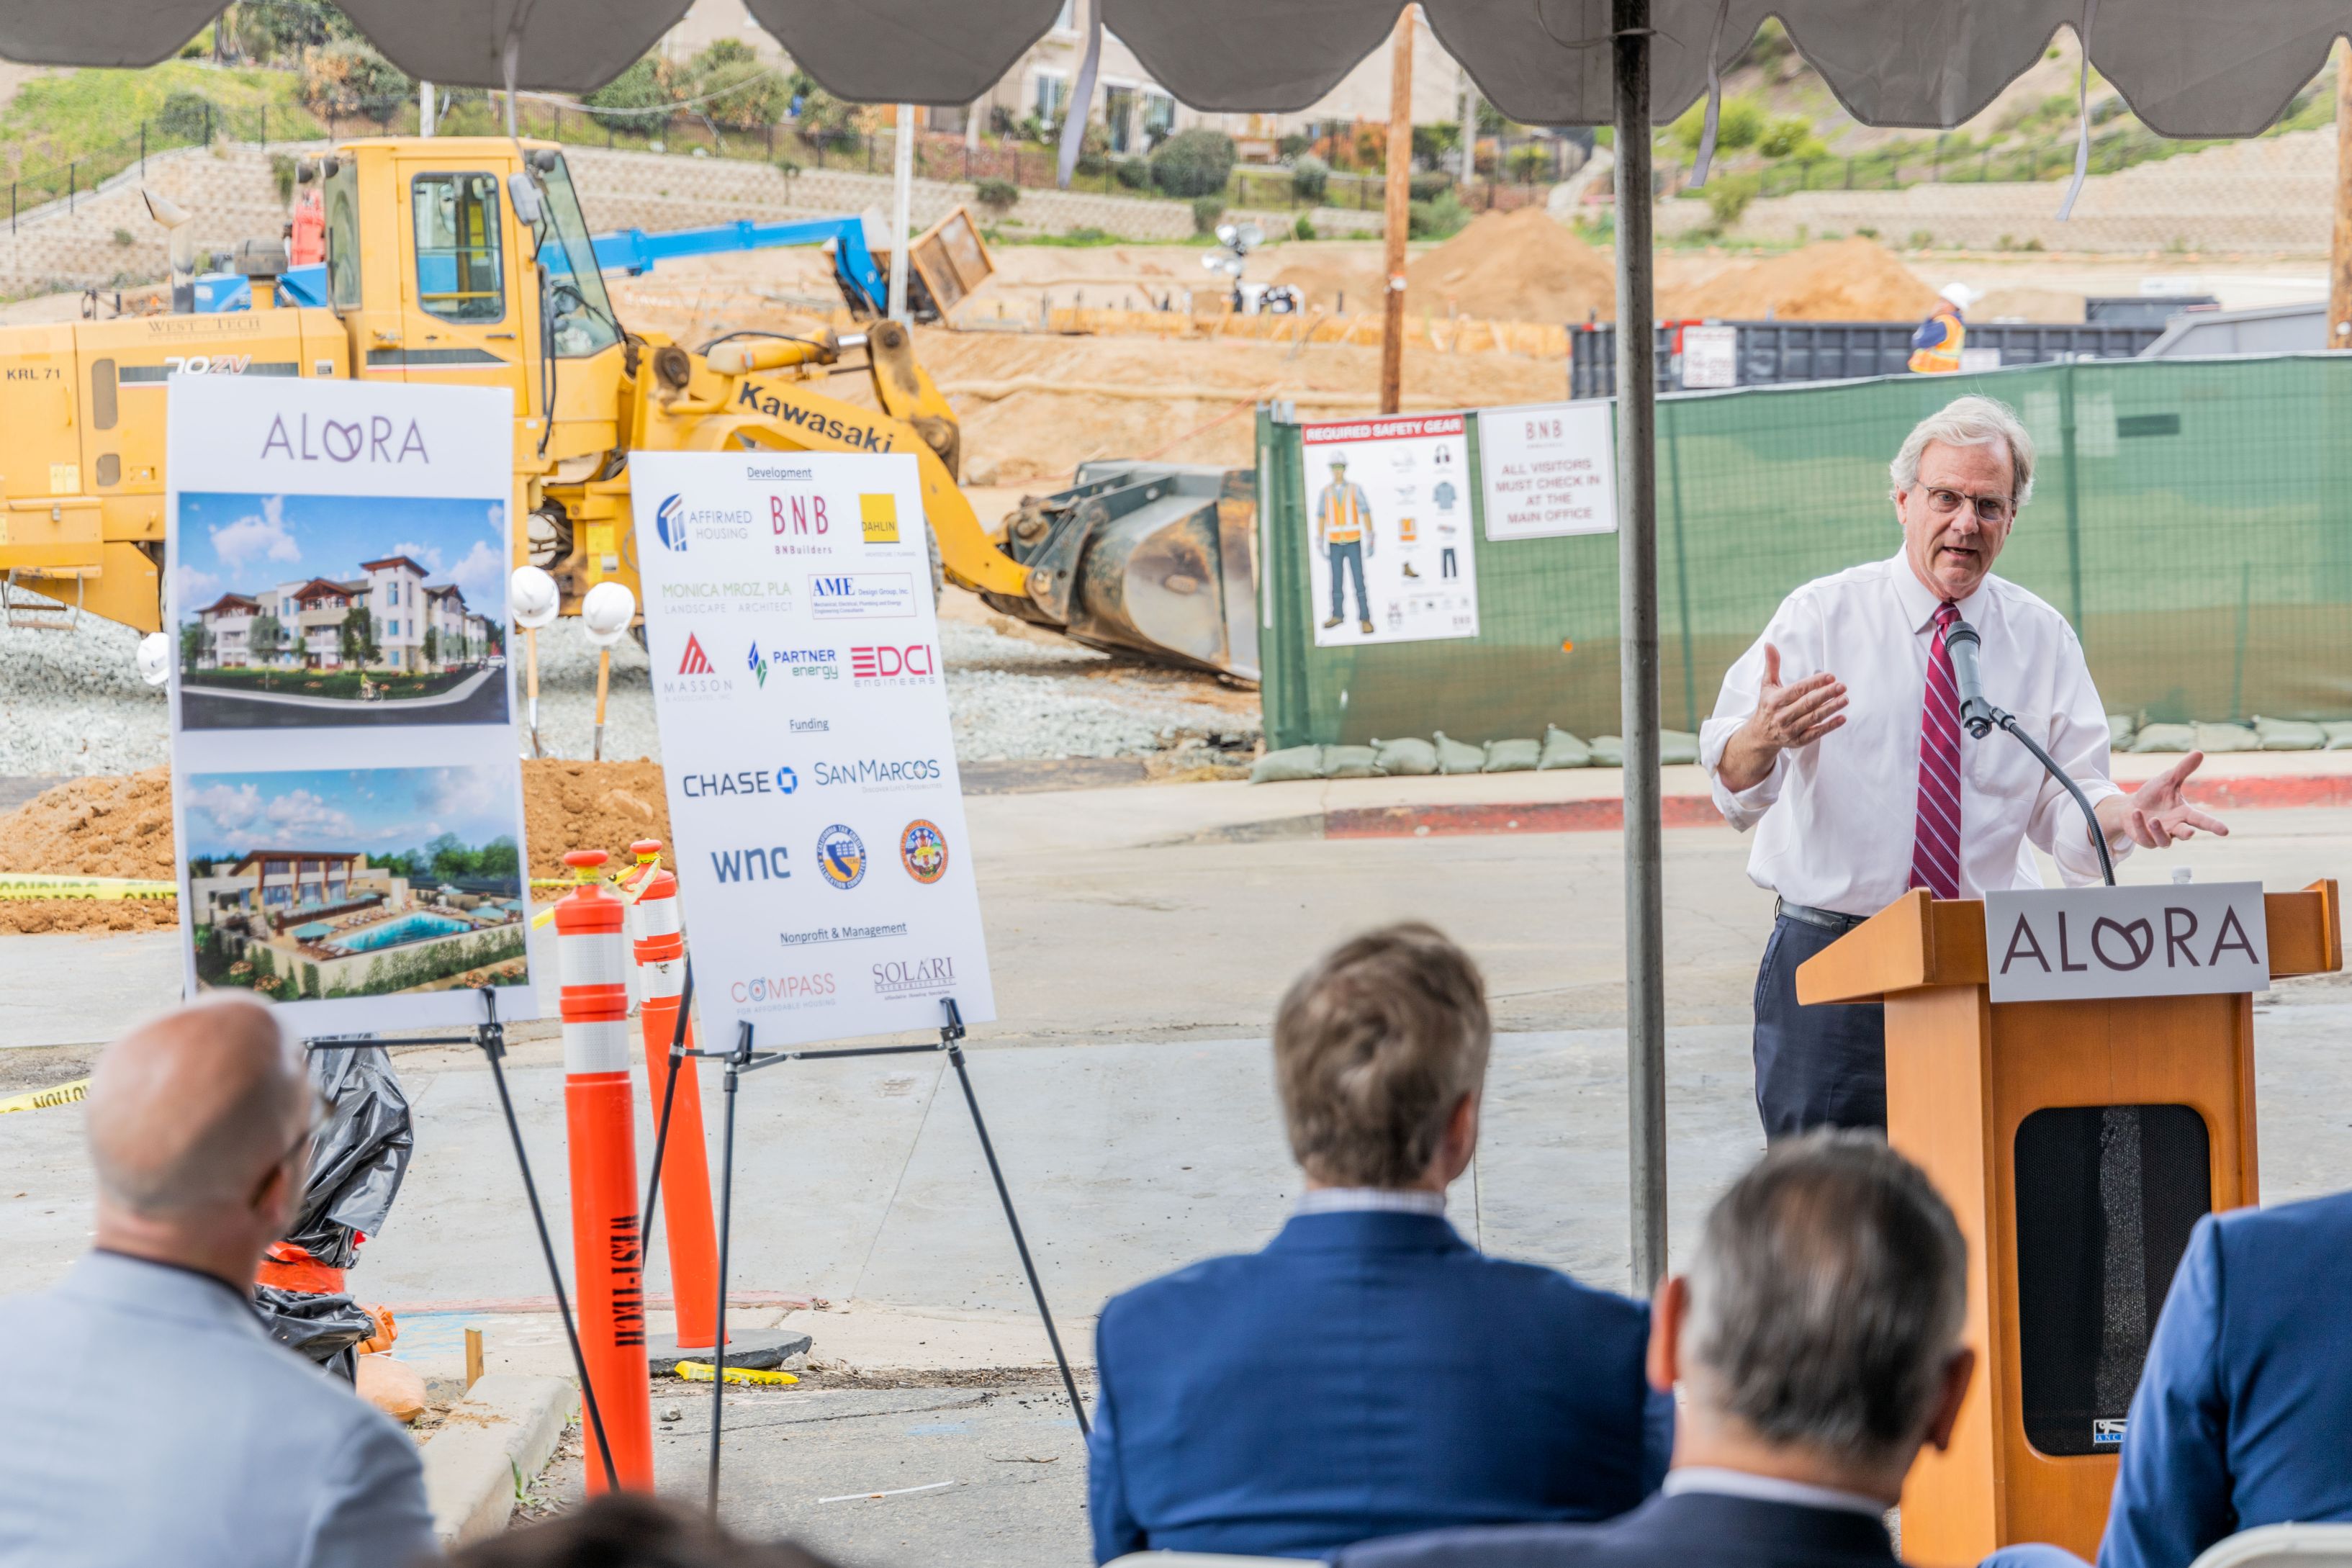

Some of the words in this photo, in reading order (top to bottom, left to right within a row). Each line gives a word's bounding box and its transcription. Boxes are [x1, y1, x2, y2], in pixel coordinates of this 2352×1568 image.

[6, 368, 40, 380] KRL
[43, 368, 60, 379] 71
[738, 381, 894, 454] Kawasaki
[260, 412, 430, 464] ALORA
[1306, 425, 1371, 441] REQUIRED
[1372, 420, 1423, 437] SAFETY
[1423, 419, 1461, 433] GEAR
[1526, 419, 1564, 441] BNB
[747, 467, 812, 480] Development
[1502, 464, 1527, 475] ALL
[1530, 459, 1592, 472] VISITORS
[1495, 479, 1533, 492] MUST
[1536, 477, 1582, 490] CHECK
[1587, 475, 1600, 485] IN
[1526, 494, 1542, 506] AT
[1546, 493, 1572, 504] THE
[689, 510, 753, 524] AFFIRMED
[770, 495, 829, 535] BNB
[1508, 511, 1541, 523] MAIN
[1544, 508, 1593, 522] OFFICE
[696, 528, 749, 540] HOUSING
[861, 521, 896, 532] DAHLIN
[775, 545, 833, 555] BNBuilders
[662, 584, 720, 598] MONICA
[722, 582, 765, 598] MROZ,
[767, 582, 792, 596] PLA
[813, 577, 855, 597] AME
[664, 603, 726, 614] LANDSCAPE
[738, 602, 793, 613] ARCHITECT
[773, 649, 837, 663] PARTNER
[793, 664, 838, 680] energy
[664, 679, 732, 693] MASSON
[854, 677, 935, 688] ENGINEERS
[790, 718, 829, 732] Funding
[684, 771, 771, 797] CHASE
[780, 929, 829, 945] Nonprofit
[831, 928, 839, 938] &
[842, 922, 907, 938] Management
[1999, 904, 2260, 975] ALORA
[873, 957, 955, 985] SOLARI
[731, 973, 835, 1003] COMPASS
[610, 1215, 645, 1347] WEST-TECH
